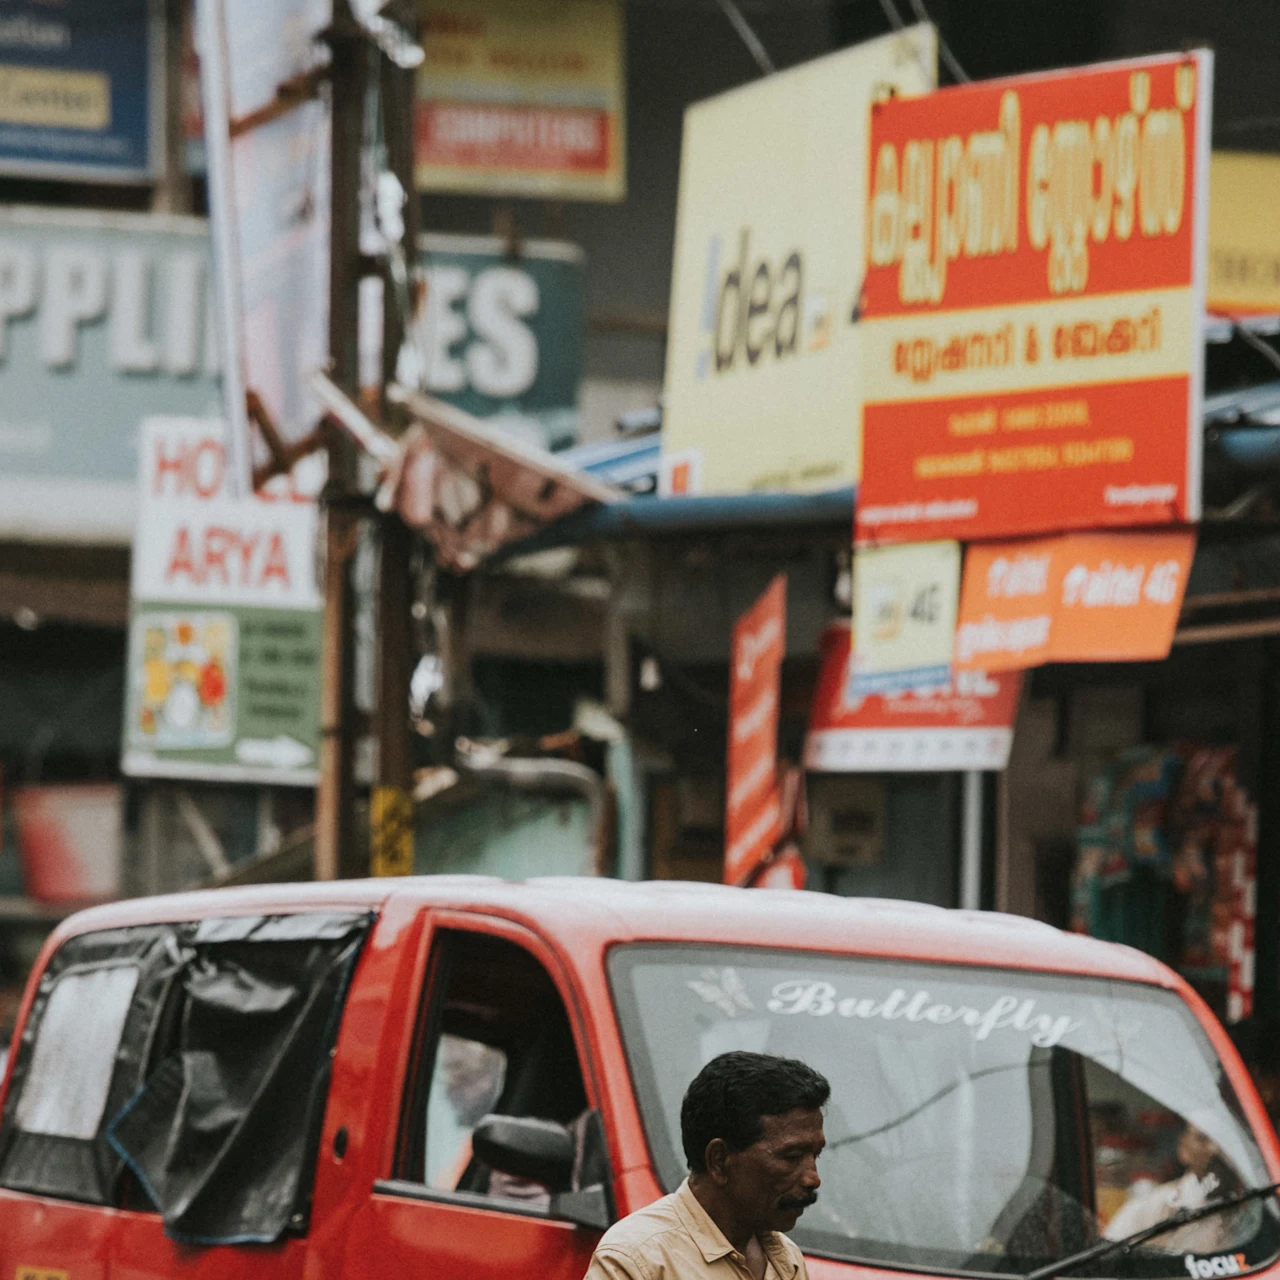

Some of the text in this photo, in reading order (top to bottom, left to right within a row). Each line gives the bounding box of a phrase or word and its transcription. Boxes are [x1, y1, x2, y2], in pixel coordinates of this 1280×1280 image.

[167, 527, 292, 591] ARYA
[766, 978, 1085, 1049] Butterfly
[1184, 1253, 1251, 1280] focuz
